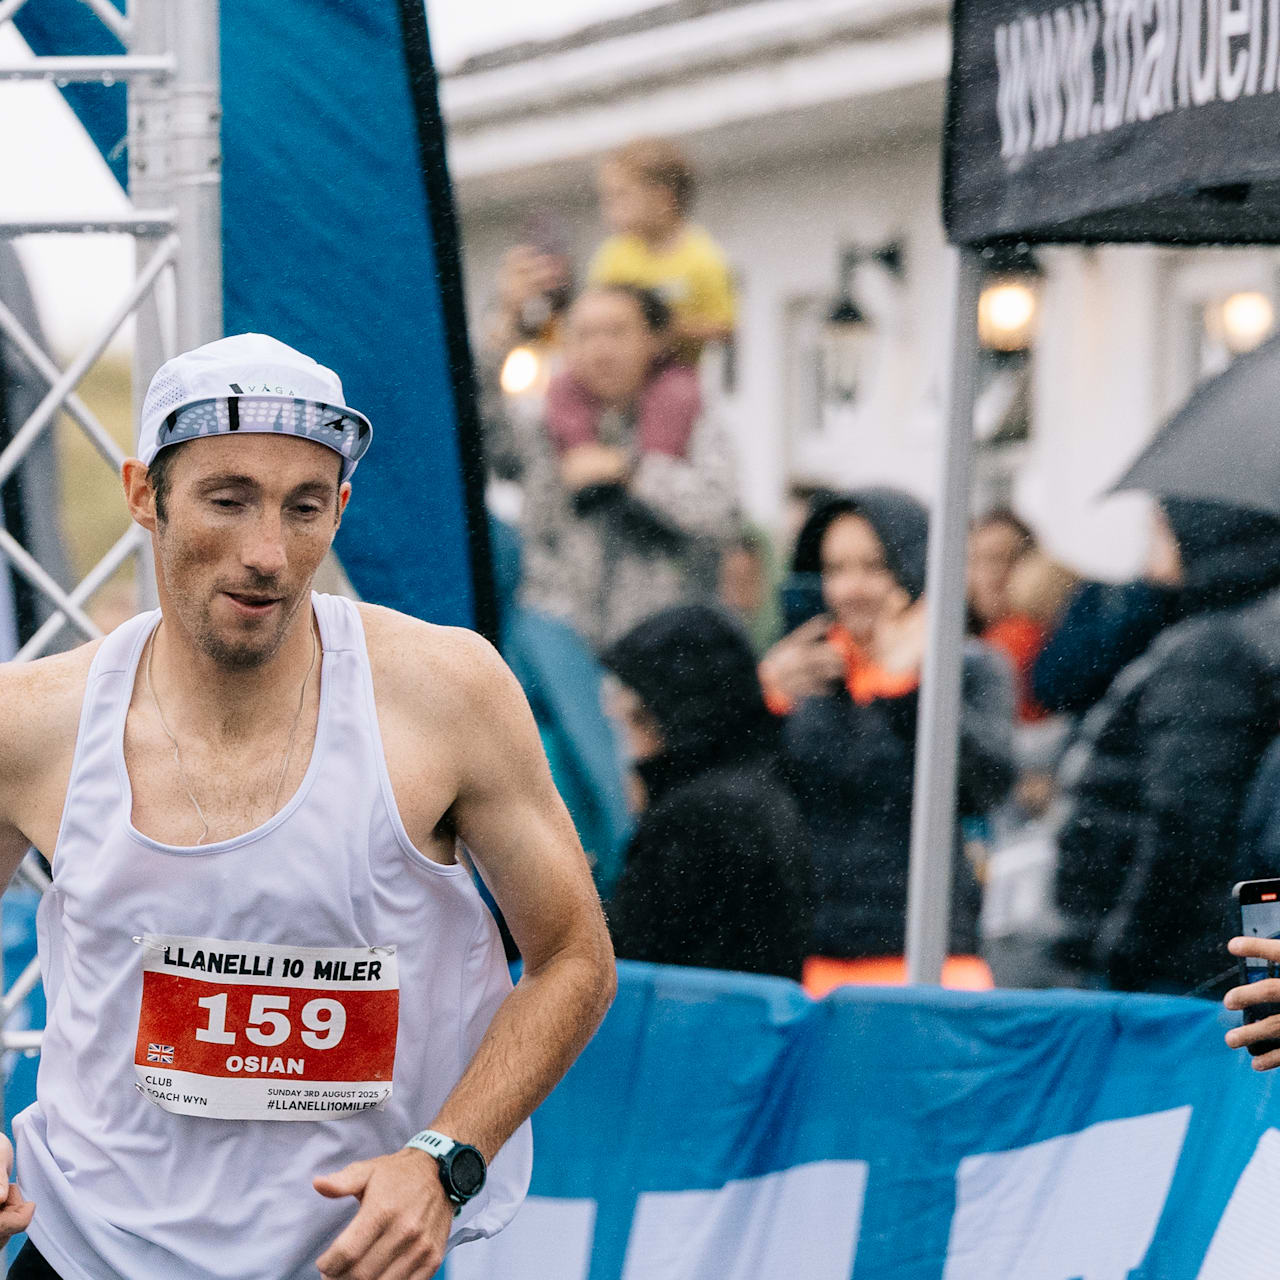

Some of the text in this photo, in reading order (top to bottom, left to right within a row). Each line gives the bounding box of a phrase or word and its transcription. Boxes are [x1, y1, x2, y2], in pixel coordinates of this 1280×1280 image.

[163, 946, 382, 981] LLANELLI 10 MILER
[195, 992, 347, 1050] 159
[225, 1055, 305, 1075] OSIAN
[145, 1075, 172, 1087] CLUB
[147, 1088, 208, 1106] OACH WYN
[267, 1088, 380, 1099] SUNDAY 3RD AUGUST 2025
